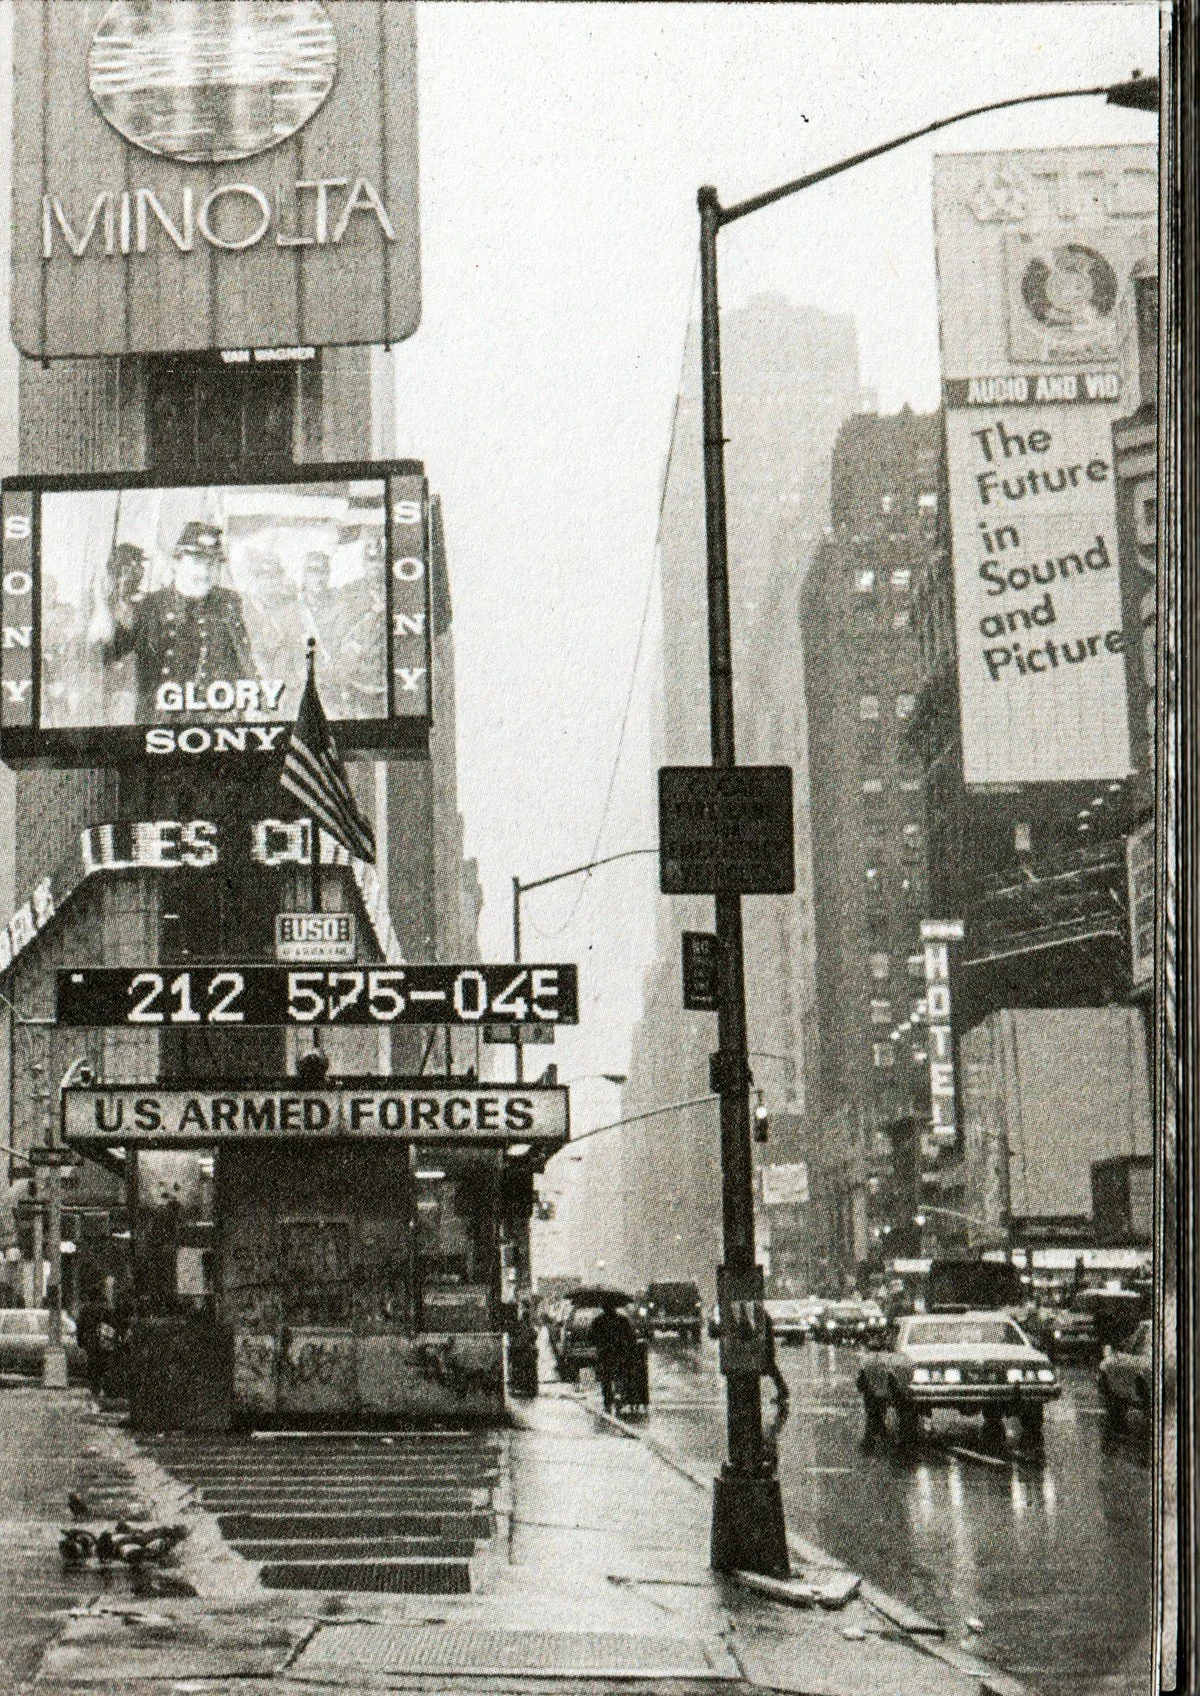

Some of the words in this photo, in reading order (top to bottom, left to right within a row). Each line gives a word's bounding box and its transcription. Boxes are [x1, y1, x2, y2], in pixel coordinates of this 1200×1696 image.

[41, 178, 397, 259] MINOLTA
[221, 350, 250, 363] VAN
[254, 347, 316, 362] WAGNER
[968, 377, 1029, 402] AUDIO
[1035, 374, 1078, 400] AND
[971, 421, 1052, 462] The
[975, 458, 1109, 505] Future
[978, 521, 1020, 554] in
[978, 535, 1112, 597] Sound
[2, 515, 32, 702] SONY
[394, 500, 427, 691] SONY
[979, 592, 1057, 639] and
[982, 628, 1125, 682] Picture
[156, 680, 287, 713] GLORY
[145, 727, 286, 755] SONY
[292, 918, 339, 941] USO
[128, 972, 245, 1023] 212
[924, 942, 956, 1134] HOTEL
[96, 1098, 166, 1133] U.S.
[178, 1098, 331, 1133] ARMED
[350, 1097, 535, 1132] FORCES
